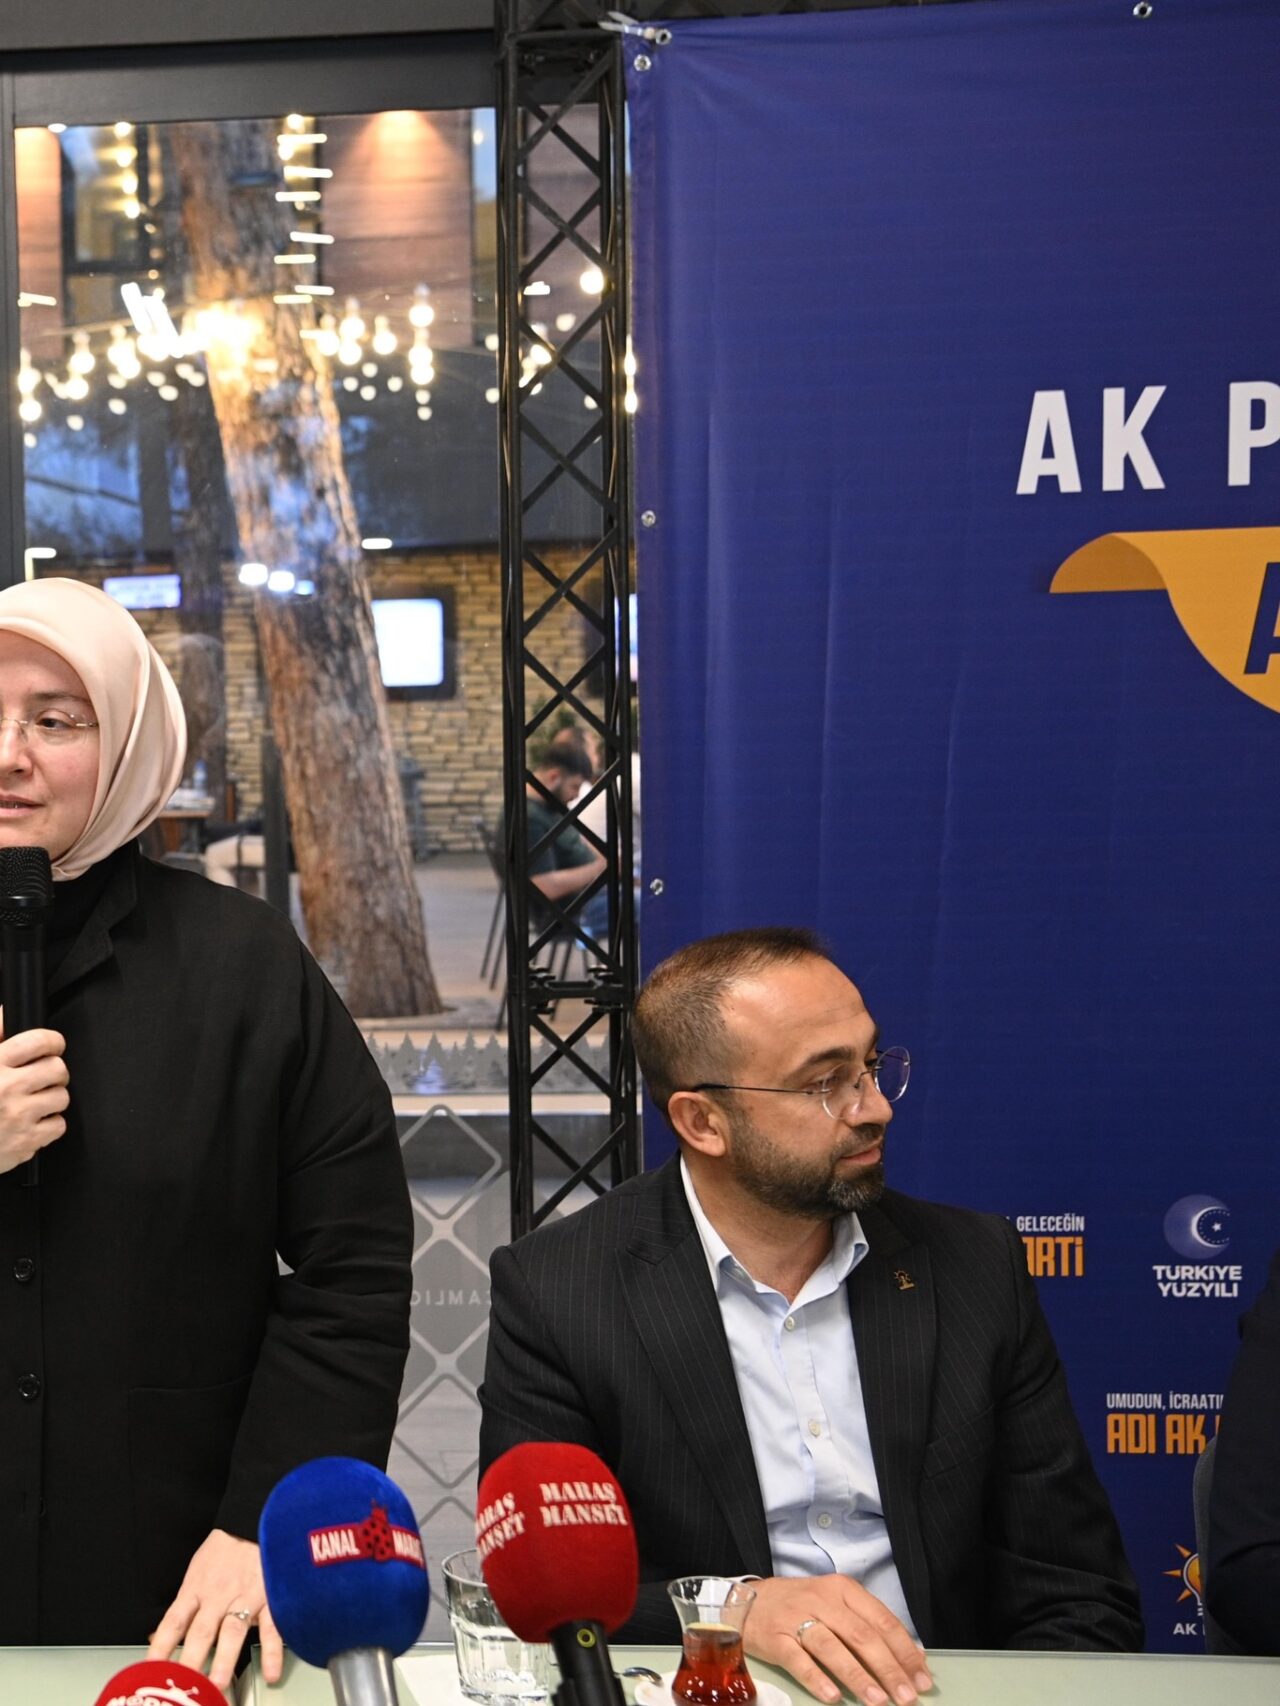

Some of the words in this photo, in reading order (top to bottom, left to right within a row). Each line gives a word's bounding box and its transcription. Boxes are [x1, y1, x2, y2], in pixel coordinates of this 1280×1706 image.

[1016, 385, 1167, 495] AK
[1016, 1213, 1085, 1232] GELECEĞİN
[1106, 1392, 1166, 1411] UMUDUN,
[1106, 1413, 1156, 1454] ADI
[1165, 1413, 1207, 1455] AK
[310, 1529, 360, 1562] KANAL
[1173, 1622, 1198, 1636] AK
